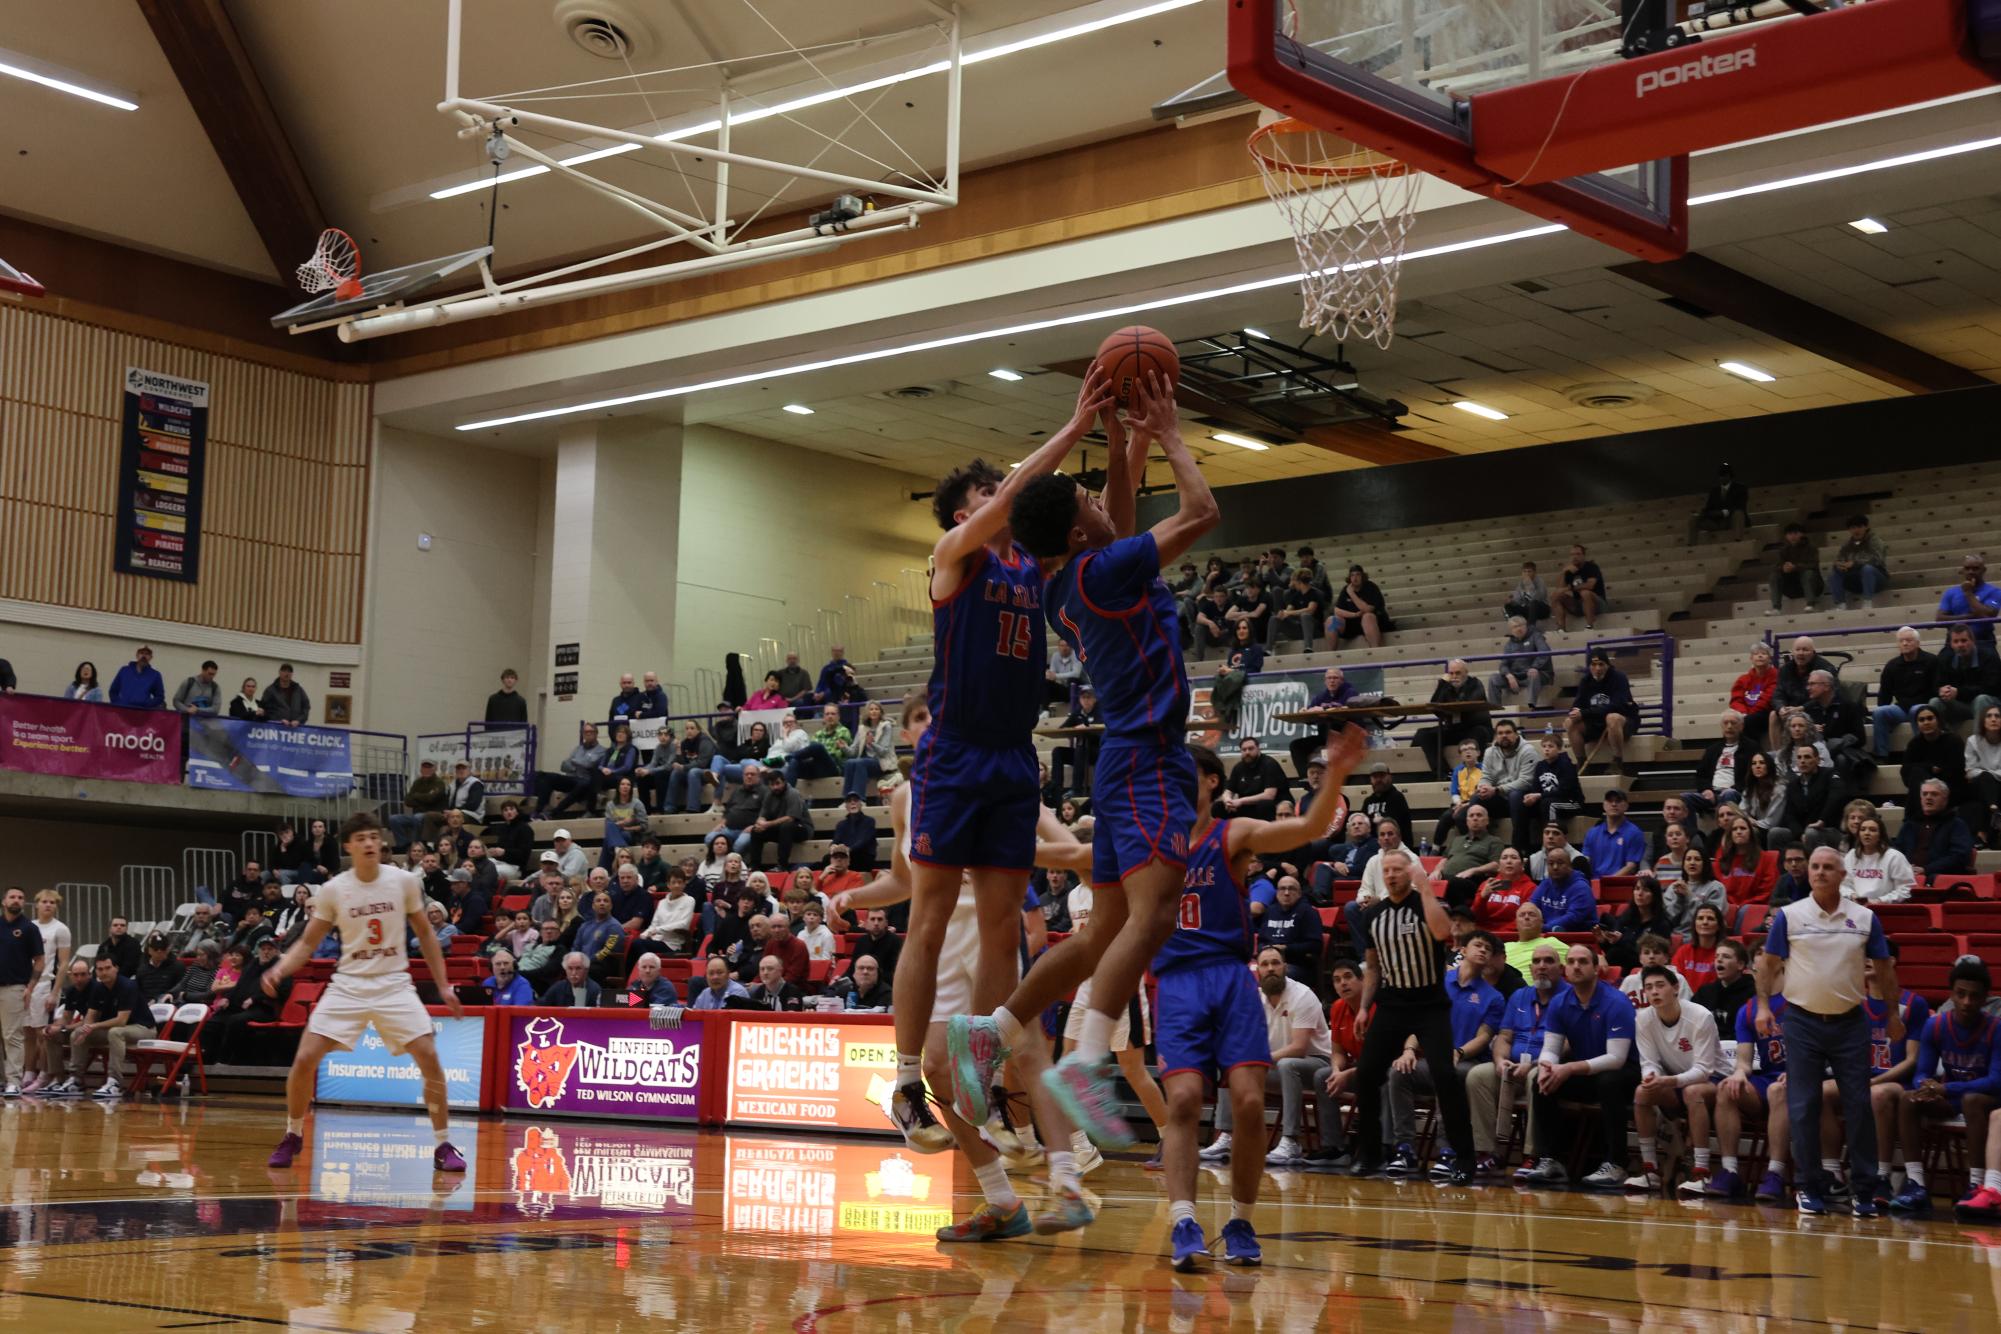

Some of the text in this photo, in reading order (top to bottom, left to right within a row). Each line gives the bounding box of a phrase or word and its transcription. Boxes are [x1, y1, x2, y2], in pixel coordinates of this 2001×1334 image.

[144, 375, 206, 397] NORTHWEST
[155, 500, 186, 513] LOGGERS
[154, 540, 183, 552] PIRATES
[148, 558, 182, 571] BEARCATS
[996, 610, 1031, 660] 15
[105, 732, 165, 752] moda
[248, 727, 345, 748] JOIN THE CLICK.
[1176, 892, 1201, 930] 0
[367, 918, 383, 945] 3
[612, 1041, 671, 1055] LINFIELD
[740, 1026, 840, 1056] MUCHAS
[580, 1048, 698, 1084] WILDCATS
[850, 1048, 884, 1063] OPEN
[328, 1060, 470, 1082] Insurance made you.
[736, 1059, 840, 1091] GRACIAS
[577, 1089, 695, 1105] TED WILSON GYMNASIUM
[737, 1101, 836, 1118] MEXICAN FOOD
